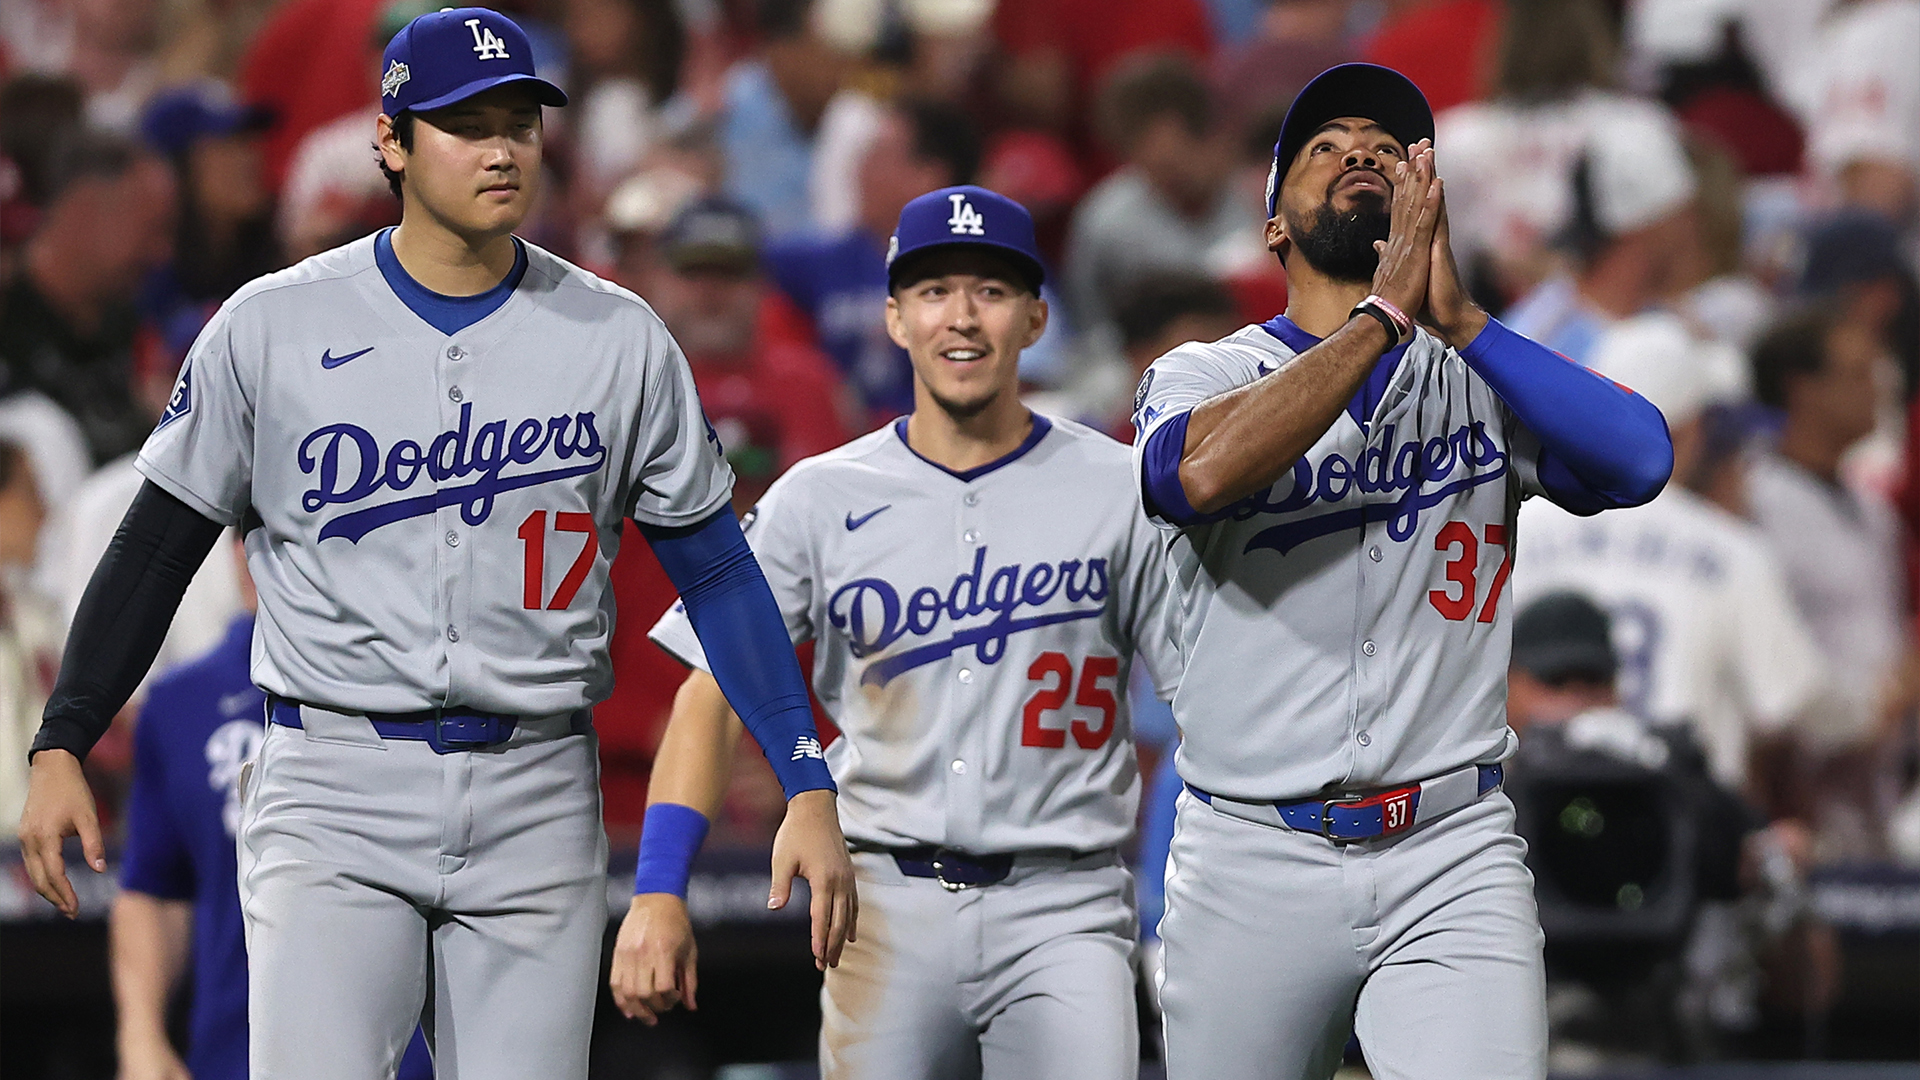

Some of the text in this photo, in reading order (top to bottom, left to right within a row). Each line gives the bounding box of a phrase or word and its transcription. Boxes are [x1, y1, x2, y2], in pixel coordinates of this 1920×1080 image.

[464, 19, 510, 60] LA
[947, 193, 985, 236] LA
[298, 402, 606, 526] Dodgers
[517, 510, 599, 610] 17
[828, 545, 1109, 665] Dodgers
[1428, 520, 1511, 623] 37
[1021, 651, 1119, 750] 25
[1387, 799, 1407, 828] 37
